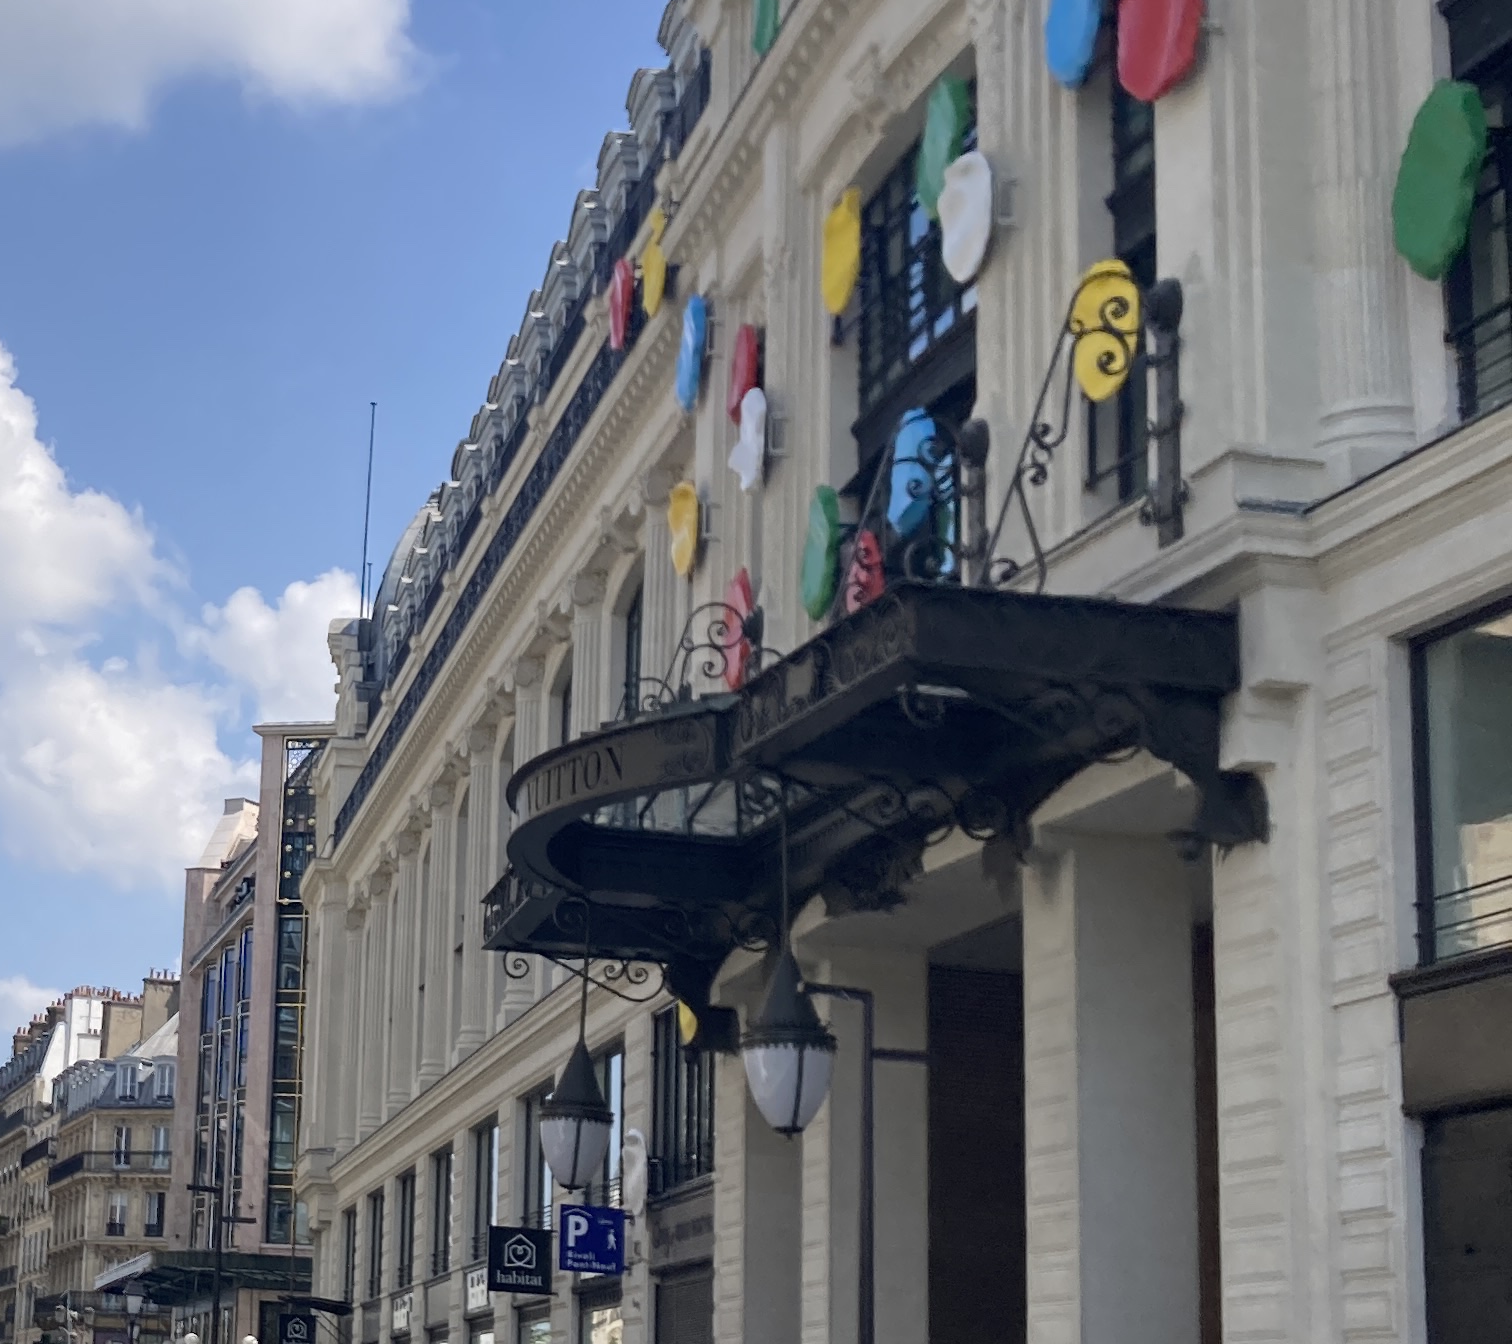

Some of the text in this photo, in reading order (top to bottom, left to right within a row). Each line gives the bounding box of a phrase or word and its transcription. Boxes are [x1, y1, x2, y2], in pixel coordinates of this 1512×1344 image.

[526, 743, 625, 816] VUITTON
[567, 1214, 589, 1247] P
[496, 1269, 544, 1287] habitat
